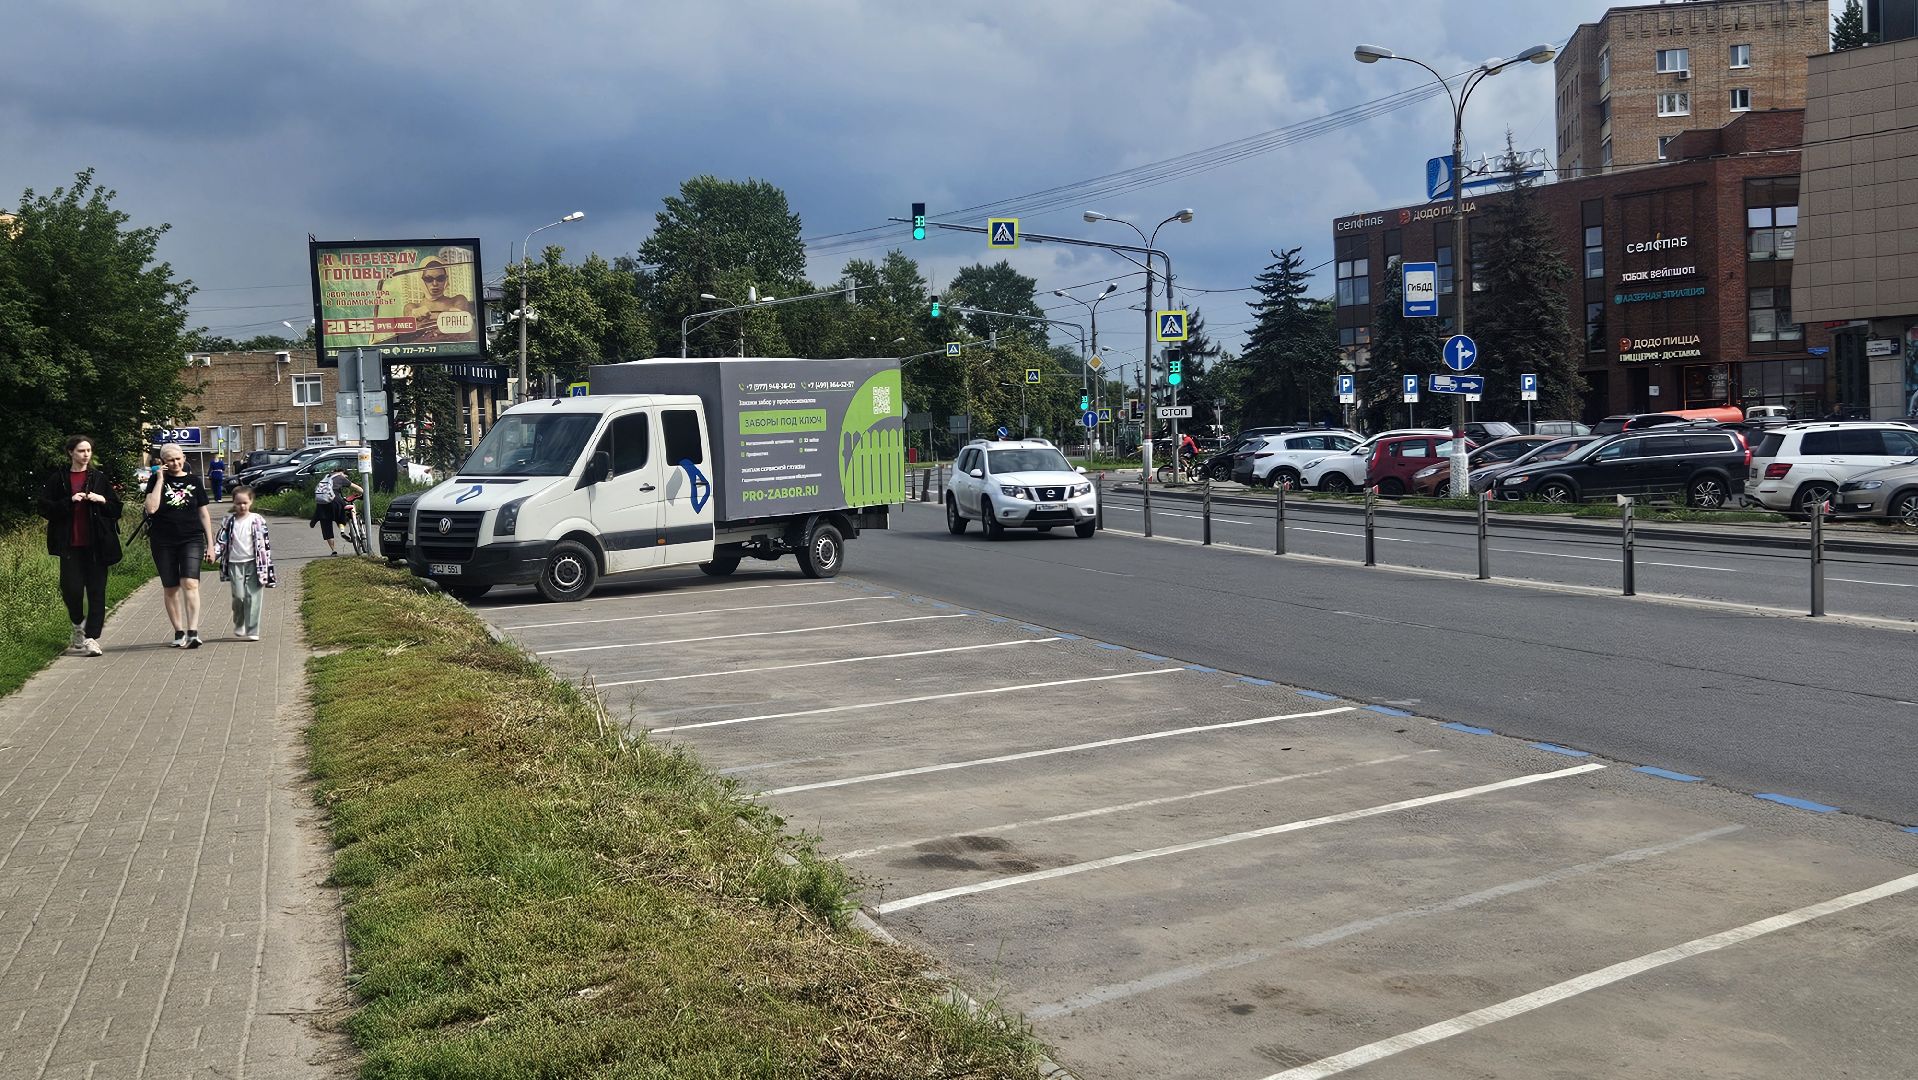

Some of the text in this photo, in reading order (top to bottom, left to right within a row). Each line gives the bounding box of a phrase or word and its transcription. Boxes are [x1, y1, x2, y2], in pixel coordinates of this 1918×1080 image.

[1413, 201, 1476, 222] ДОДО ПИЦА
[323, 252, 417, 266] К ПЕРЕЕЗДУ
[1622, 287, 1705, 302] ЛАЗЕРНАЯ ЭПИЛЯЦИЯ
[327, 321, 346, 333] 20
[348, 320, 374, 333] 525
[1633, 335, 1700, 349] ДОДО ПИЦЦА
[1620, 349, 1701, 362] ПИЦЦЕРИЯ ДОСТАВКА
[1161, 408, 1187, 417] СТОП
[745, 416, 822, 428] ЗАБОРЫ ПОД КЛЮЧ
[162, 429, 190, 440] РЭО
[742, 485, 819, 502] PRO-ZABOR.RU
